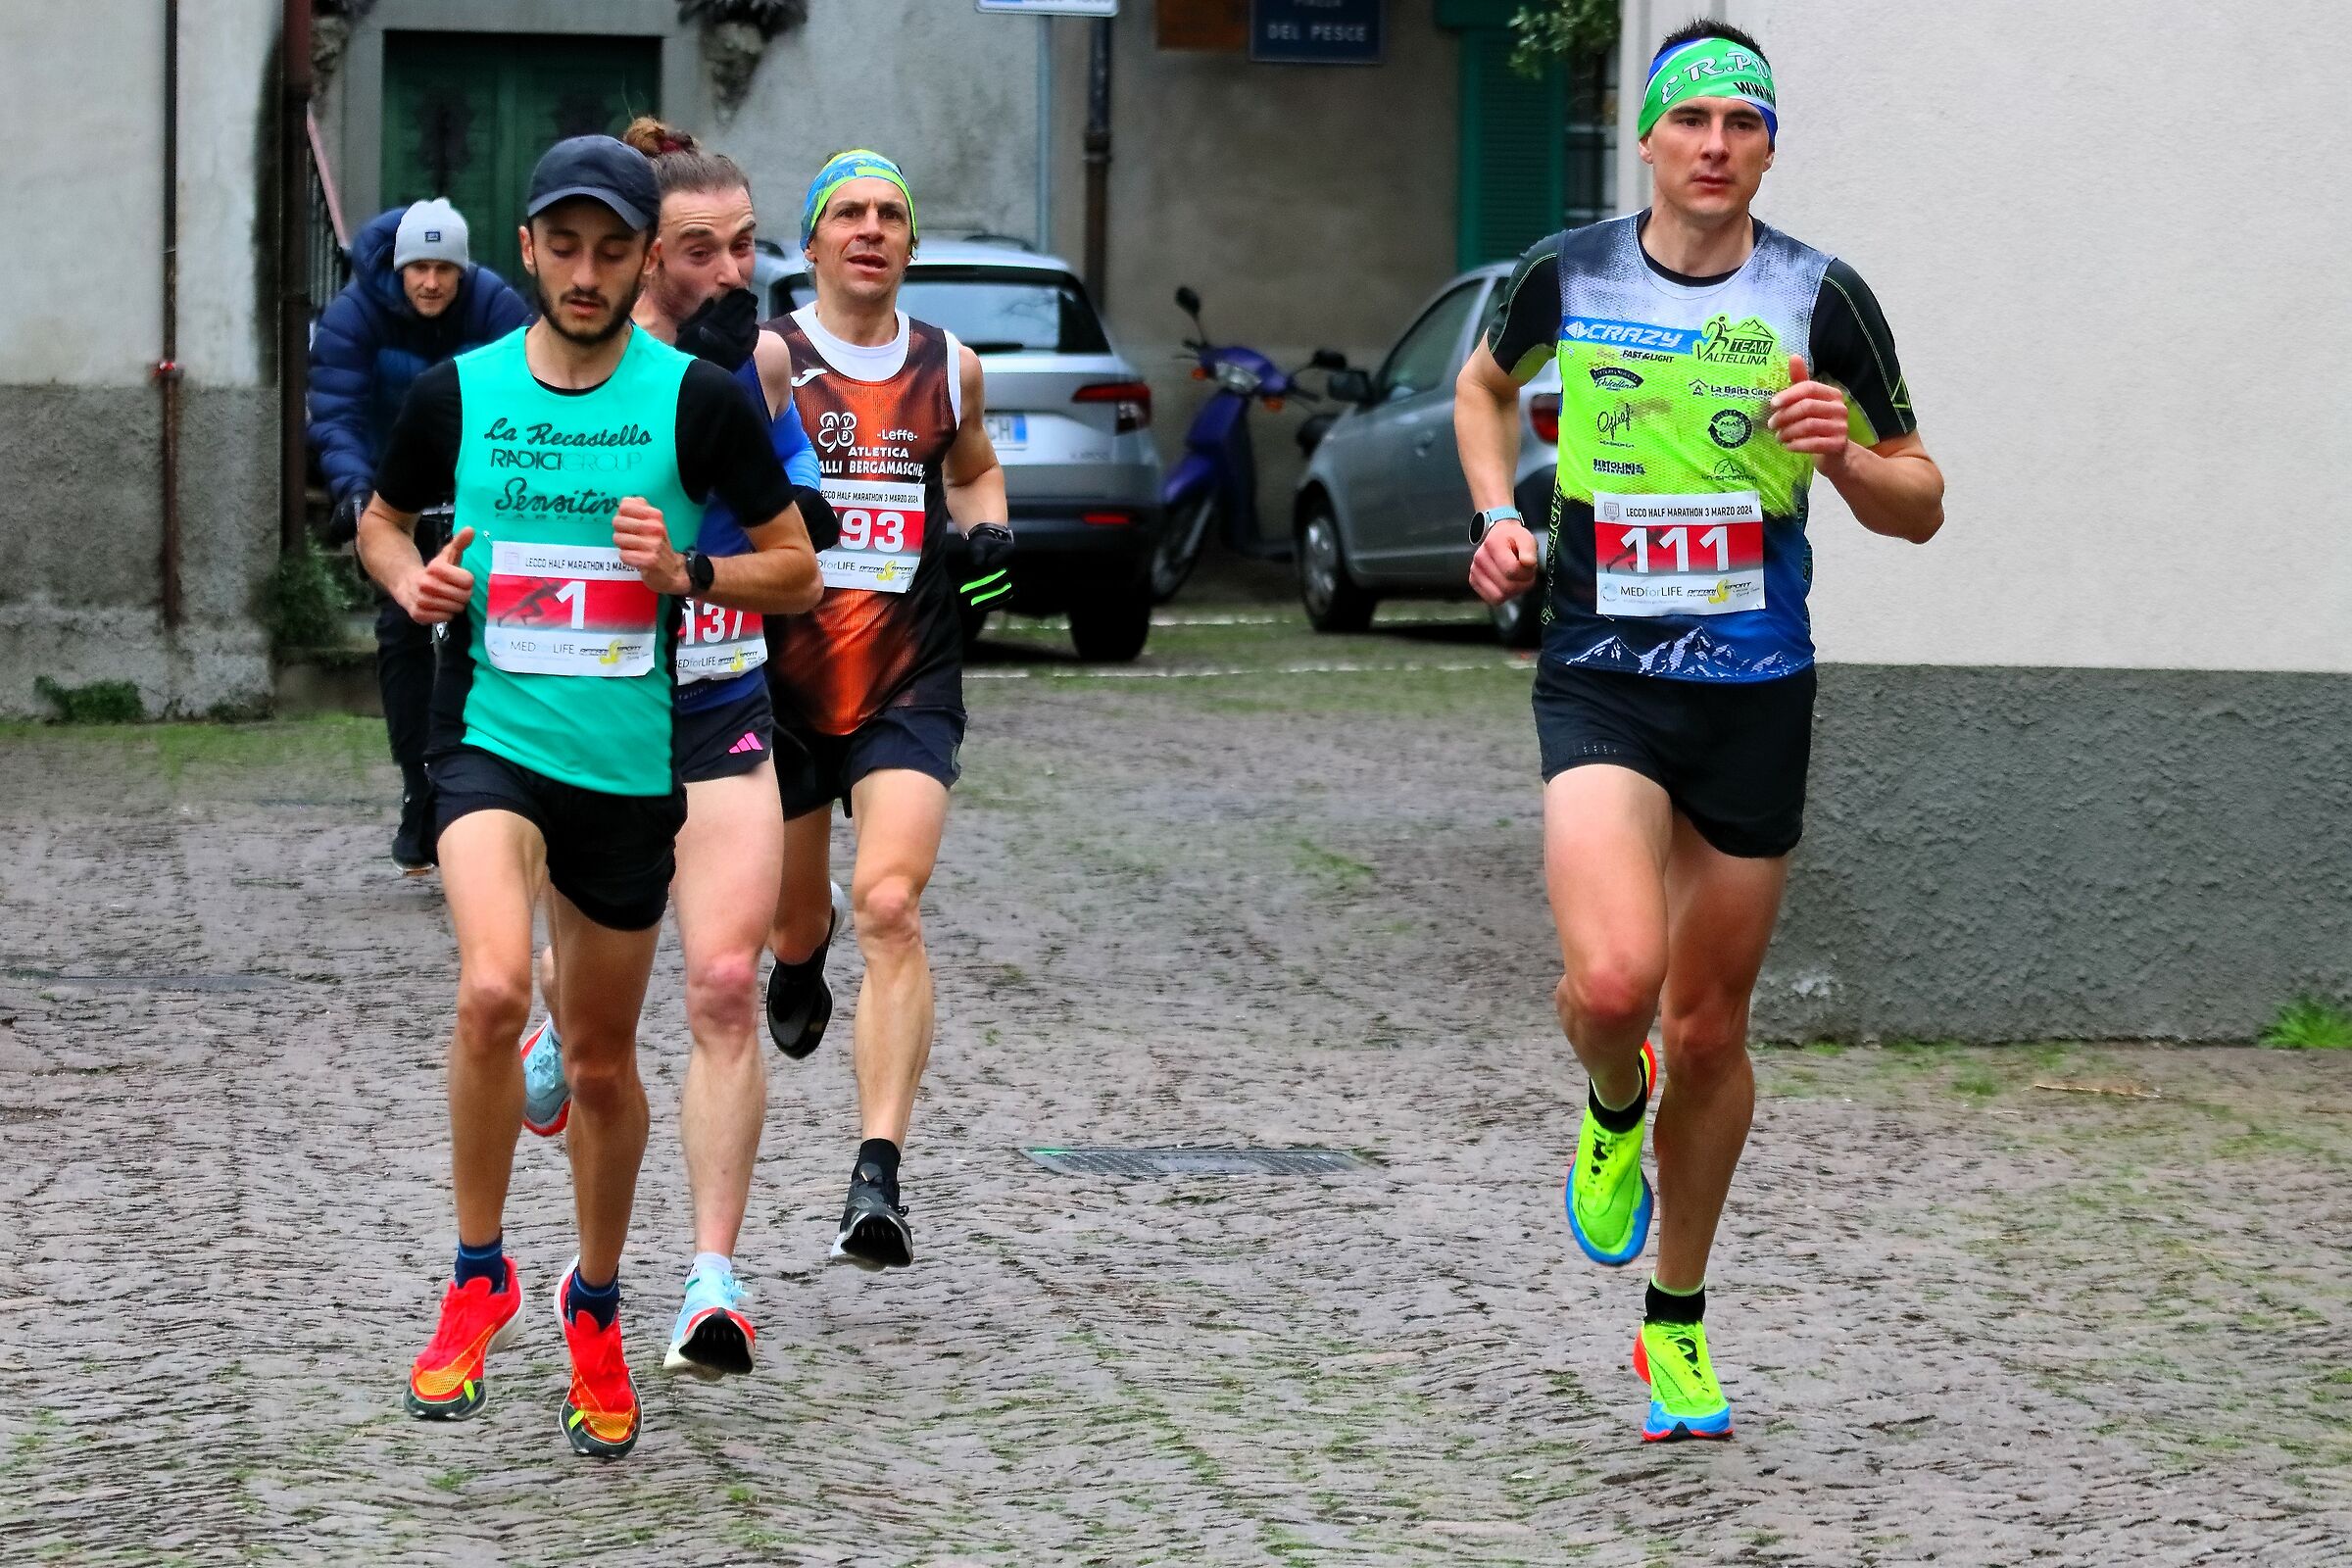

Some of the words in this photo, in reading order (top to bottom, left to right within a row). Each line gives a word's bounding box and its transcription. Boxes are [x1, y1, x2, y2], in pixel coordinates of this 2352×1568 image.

[1268, 24, 1298, 39] DEL
[1311, 24, 1365, 41] PESCE
[1587, 323, 1684, 348] CRAZY
[1696, 343, 1768, 366] VALTELLINA
[1732, 340, 1771, 354] TEAM
[484, 416, 518, 441] La
[527, 422, 654, 447] Recastello
[848, 446, 909, 459] ATLETICA
[819, 460, 843, 473] ALLI
[849, 460, 924, 477] BERGAMASCHE
[1593, 458, 1636, 470] BERTOLINI
[495, 476, 620, 514] Sensitiv
[820, 490, 836, 500] ECCO
[837, 491, 852, 501] HALF
[853, 492, 883, 503] MARATHON
[884, 493, 888, 503] 3
[889, 494, 907, 504] MARZO
[1626, 508, 1647, 517] LECCO
[1648, 508, 1666, 517] HALF
[1667, 508, 1703, 517] MARATHON
[1705, 507, 1710, 516] 3
[1712, 506, 1736, 516] MARZO
[1737, 505, 1753, 515] 2024
[833, 510, 905, 553] 93
[1620, 525, 1730, 573] 111
[525, 557, 547, 568] LECCO
[548, 559, 565, 569] HALF
[567, 560, 605, 571] MARATHON
[606, 562, 611, 571] 3
[1620, 585, 1684, 597] MEDforLIFE
[556, 581, 586, 630] 1
[676, 657, 715, 668] EDforLIFE
